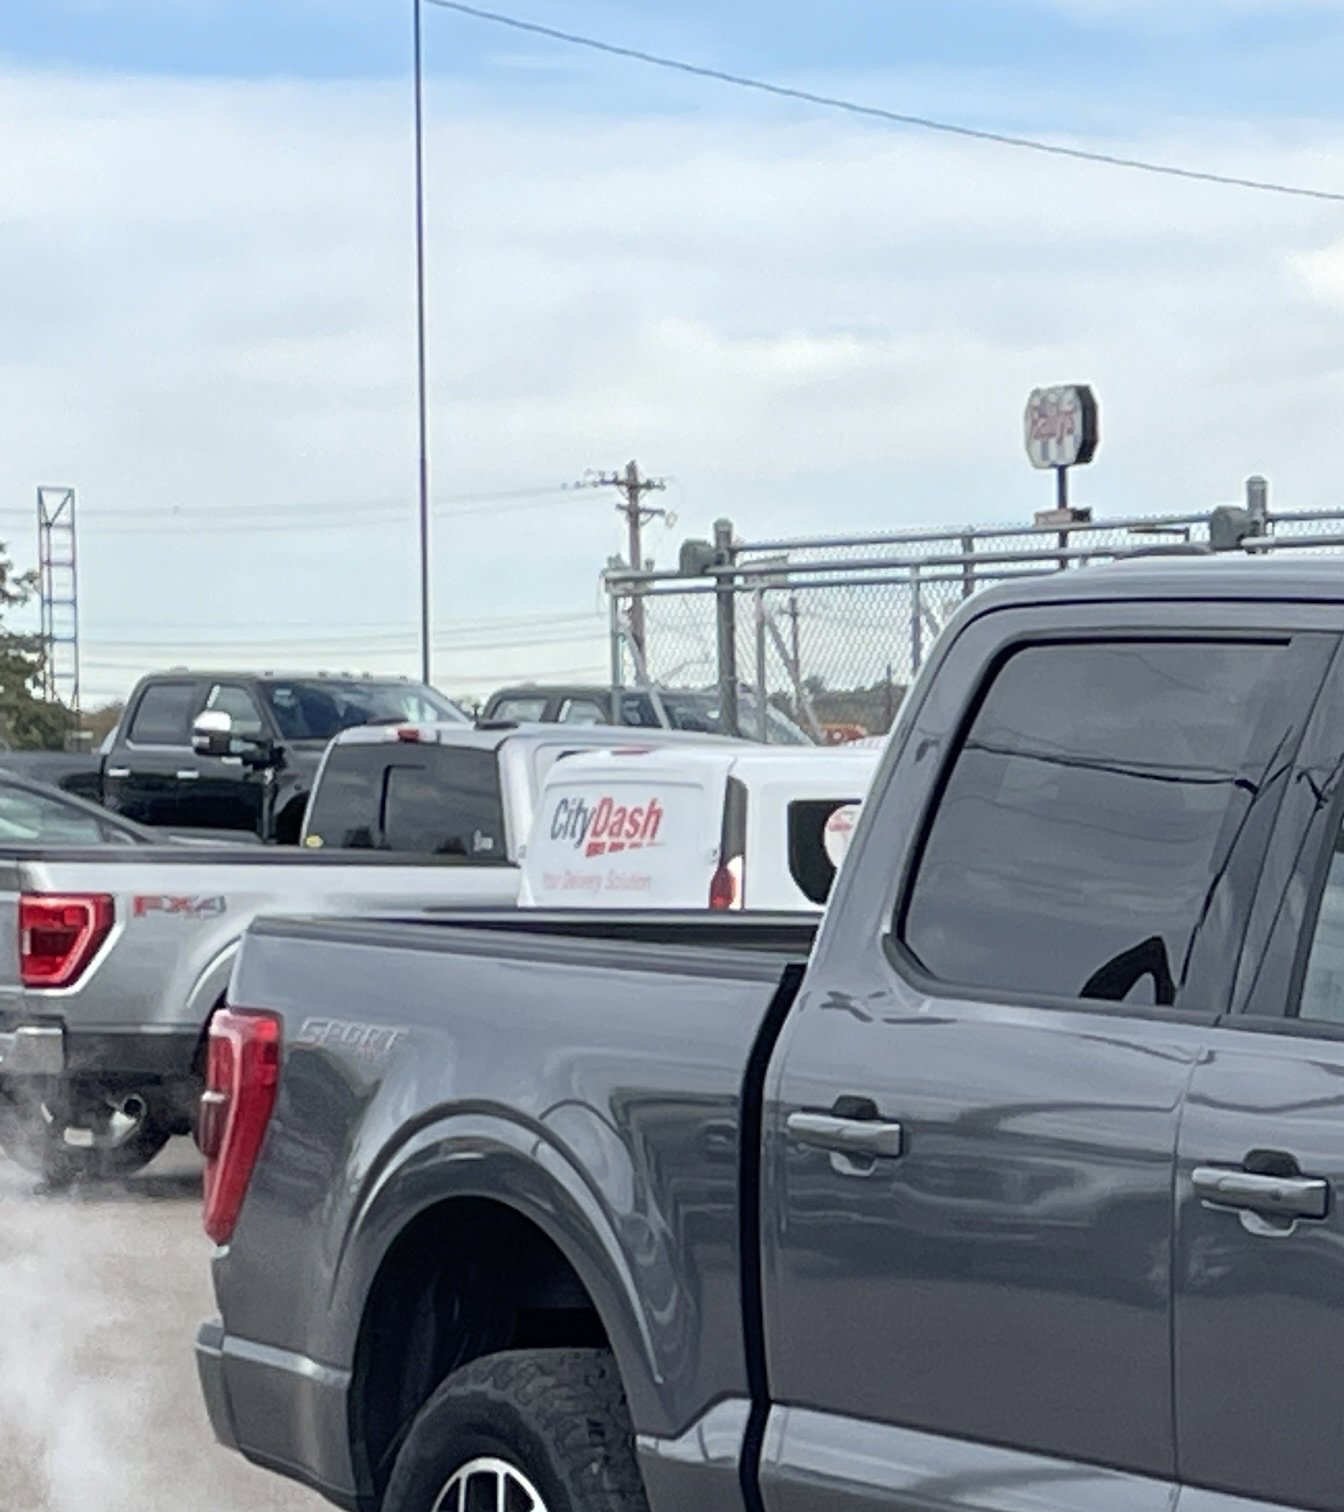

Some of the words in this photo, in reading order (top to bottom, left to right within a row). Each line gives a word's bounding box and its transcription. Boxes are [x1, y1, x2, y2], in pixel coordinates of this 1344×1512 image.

[550, 796, 664, 849] CityDash
[132, 894, 227, 919] FX4
[297, 1016, 409, 1052] SPORT
